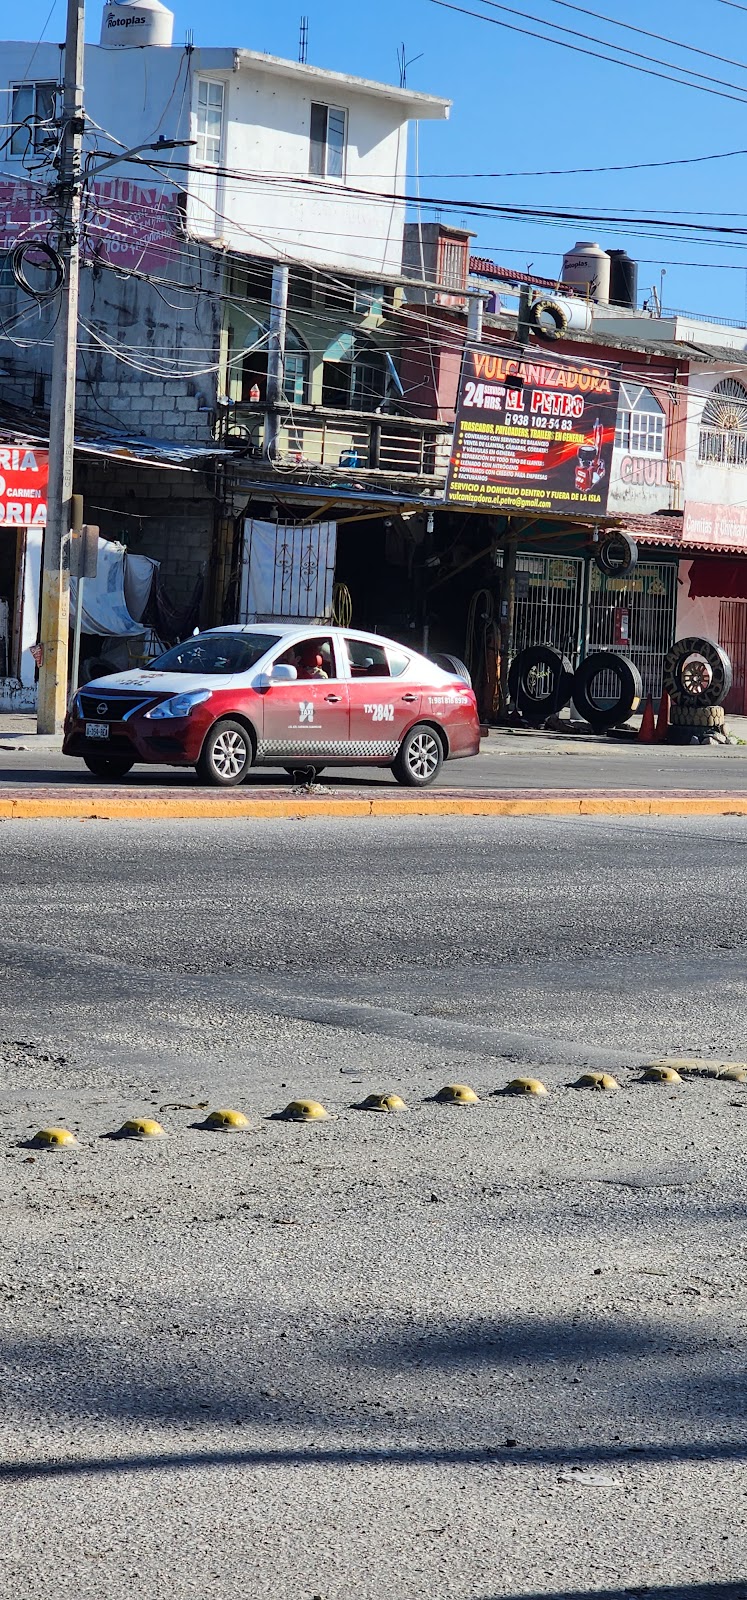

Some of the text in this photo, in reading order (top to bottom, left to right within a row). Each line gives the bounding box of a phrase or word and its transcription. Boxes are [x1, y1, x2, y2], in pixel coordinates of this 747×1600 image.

[107, 14, 146, 28] Rotoplas
[473, 353, 611, 394] VULCANIZADORA
[463, 381, 485, 408] 24
[484, 385, 506, 396] SERVICIO
[484, 395, 502, 410] HRS.
[505, 387, 585, 419] EL PETRO
[512, 414, 573, 431] 938 102 54 83
[463, 439, 478, 447] VENTA
[464, 432, 489, 441] CONTAMOS
[490, 435, 500, 443] CON
[555, 432, 562, 442] EN
[563, 432, 584, 444] GENERAL
[459, 466, 485, 474] CONTAMOS
[6, 487, 42, 498] CARMEN
[449, 491, 551, 508] vulcanizadora.el.petro@gmail.com
[450, 482, 479, 492] SERVICIO
[480, 485, 486, 493] A
[486, 485, 519, 496] DOMICILIO
[520, 488, 545, 498] DENTRO
[551, 491, 570, 500] FUERA
[571, 493, 580, 501] DE
[580, 494, 588, 502] LA
[588, 494, 601, 503] ISLA
